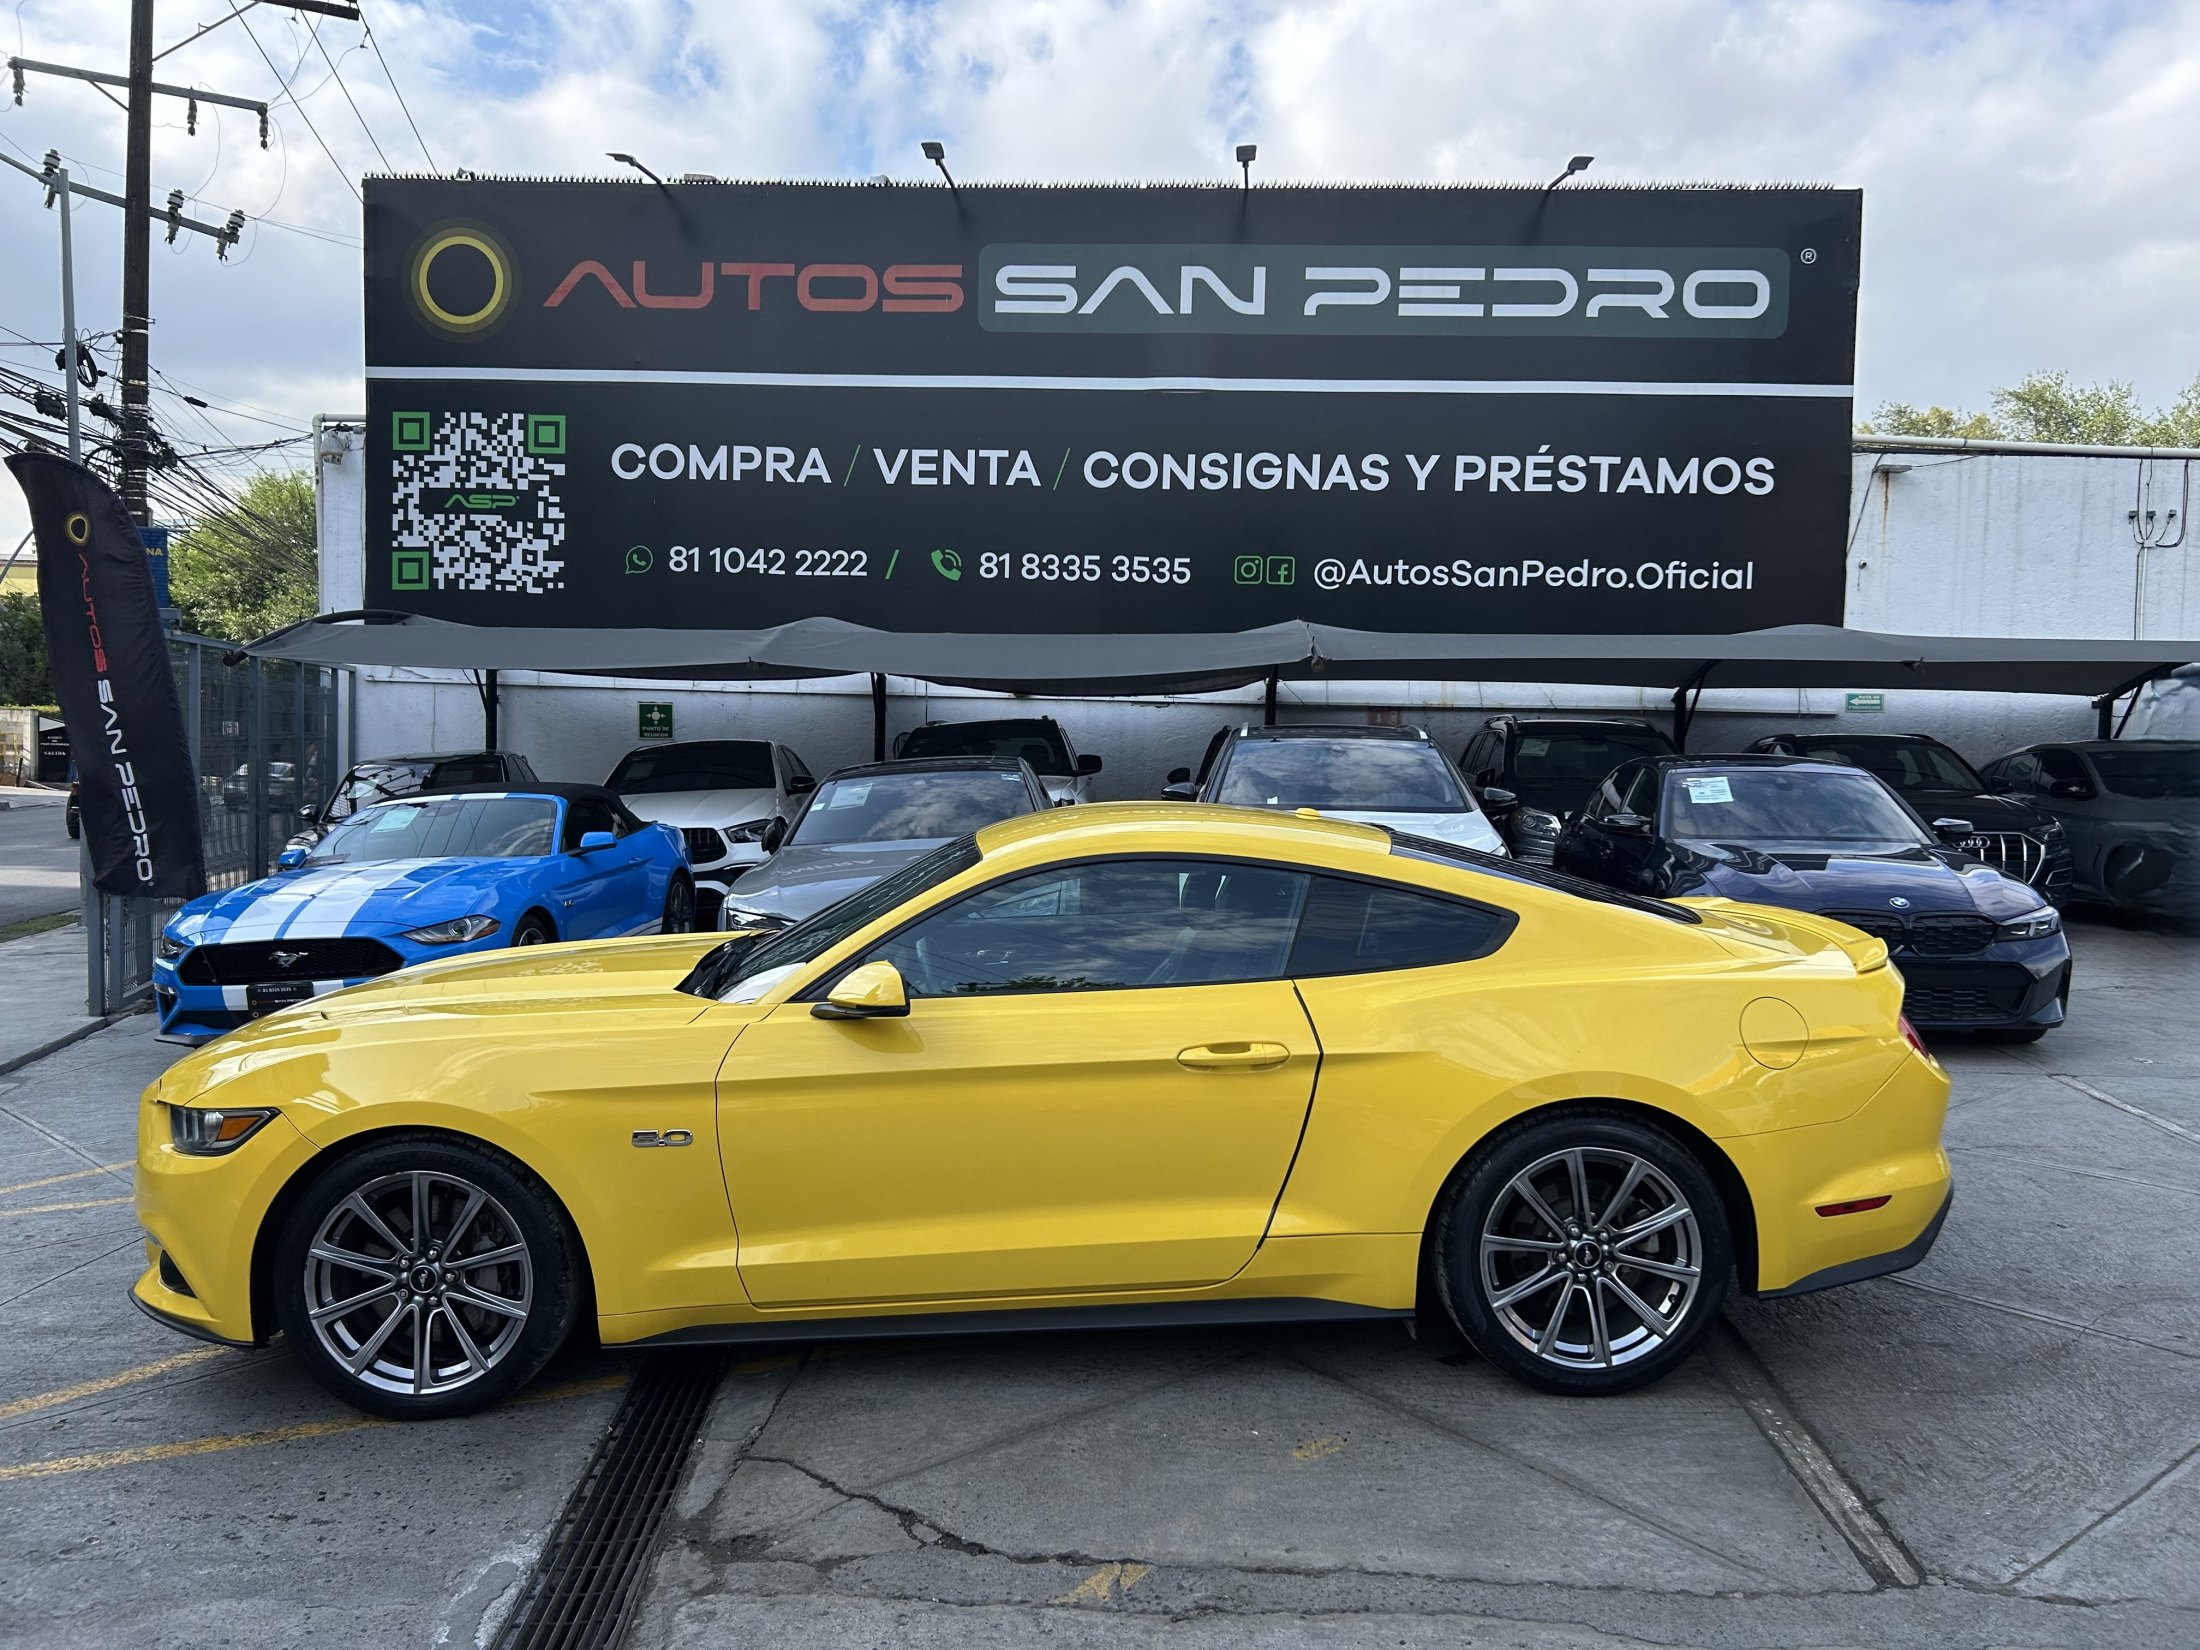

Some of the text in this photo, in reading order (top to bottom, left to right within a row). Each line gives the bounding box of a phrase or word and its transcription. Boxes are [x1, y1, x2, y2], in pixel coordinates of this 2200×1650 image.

[542, 260, 965, 313] AUTOS
[994, 264, 1267, 316] SAN
[1303, 266, 1771, 320] PEDRO
[611, 442, 832, 484] COMPRA
[872, 448, 1042, 487] VENTA
[1083, 450, 1390, 492] CONSIGNAS
[1404, 454, 1441, 491] Y
[1454, 444, 1775, 496] PRÉSTAMOS
[668, 545, 700, 573] 81
[709, 547, 786, 575] 1042
[795, 549, 868, 577] 2222
[979, 551, 1191, 585] 81 8335 3535
[1313, 558, 1754, 590] @AutosSanPedro.Oficial
[79, 553, 153, 881] AUTOS SAN PEDRO
[631, 1128, 693, 1148] 5.0
